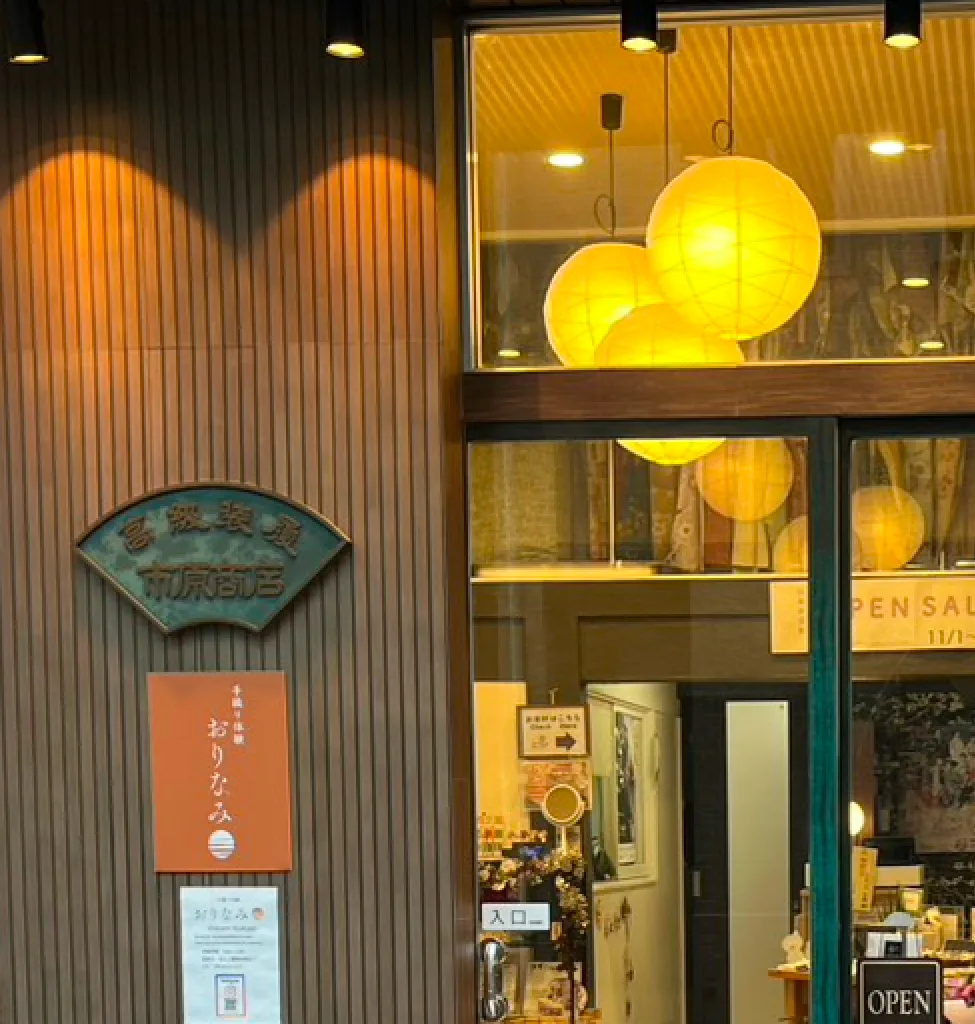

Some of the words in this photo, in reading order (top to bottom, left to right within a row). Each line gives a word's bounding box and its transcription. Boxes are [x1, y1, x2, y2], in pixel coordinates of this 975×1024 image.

[851, 596, 909, 618] PEN
[207, 717, 233, 825] おりなみ
[867, 989, 931, 1016] OPEN
